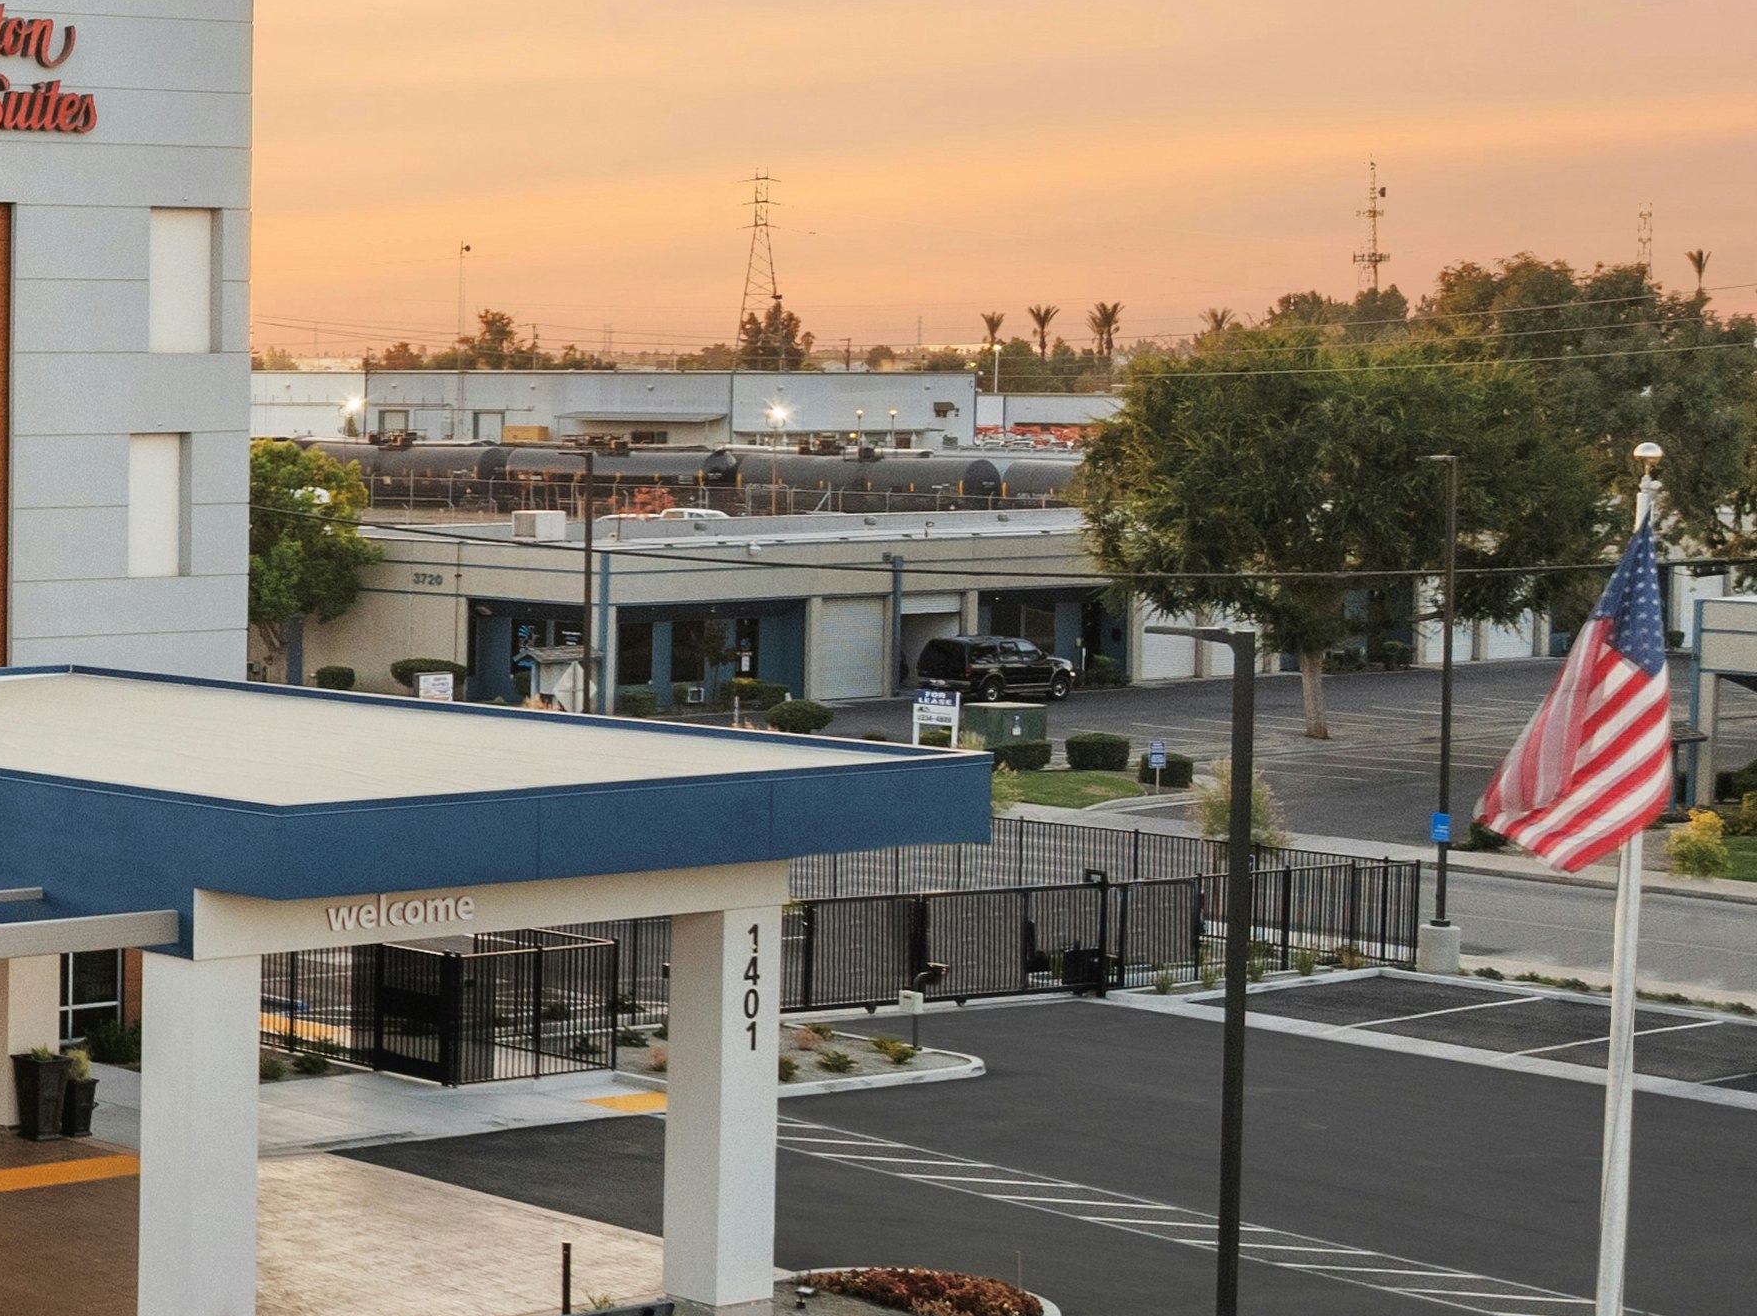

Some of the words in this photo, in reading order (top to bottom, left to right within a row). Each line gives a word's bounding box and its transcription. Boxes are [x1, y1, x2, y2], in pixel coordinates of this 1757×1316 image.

[413, 572, 443, 586] 3720
[918, 697, 952, 705] LEASE
[925, 691, 946, 699] FOR
[326, 894, 475, 931] welcome
[743, 924, 760, 1051] 1401
